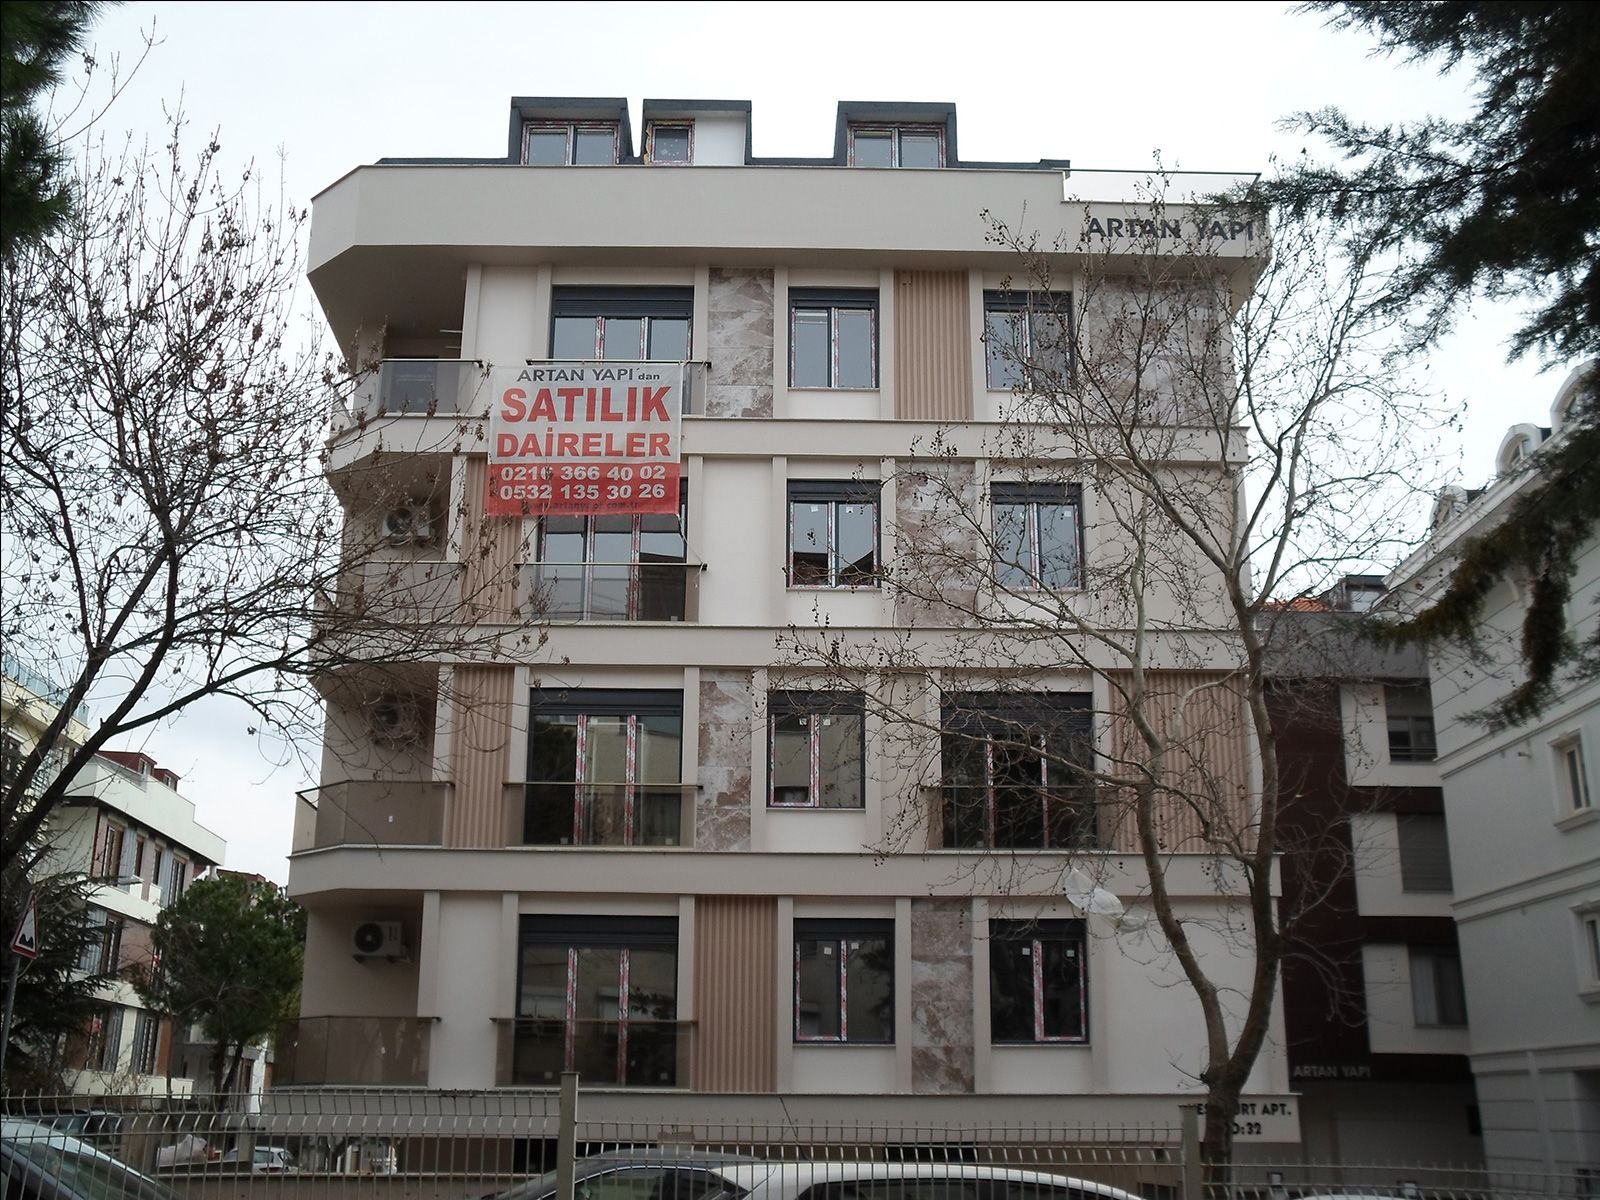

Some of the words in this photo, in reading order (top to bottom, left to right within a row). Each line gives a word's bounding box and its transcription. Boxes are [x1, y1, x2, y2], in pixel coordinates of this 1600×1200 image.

[1087, 218, 1182, 238] ARTAN
[1197, 220, 1254, 241] YAPI
[516, 369, 585, 382] ARTAN
[500, 385, 672, 423] SATILIK
[496, 427, 671, 458] DAİRELER
[500, 466, 553, 481] 0216
[560, 466, 600, 481] 366
[606, 466, 633, 481] 40
[639, 465, 666, 480] 02
[500, 485, 553, 500] 0532
[560, 484, 600, 499] 135
[606, 485, 632, 499] 30
[639, 483, 666, 498] 26
[1294, 1065, 1337, 1078] ARTAN
[1341, 1065, 1371, 1078] YAPI
[1261, 1103, 1292, 1116] APT.
